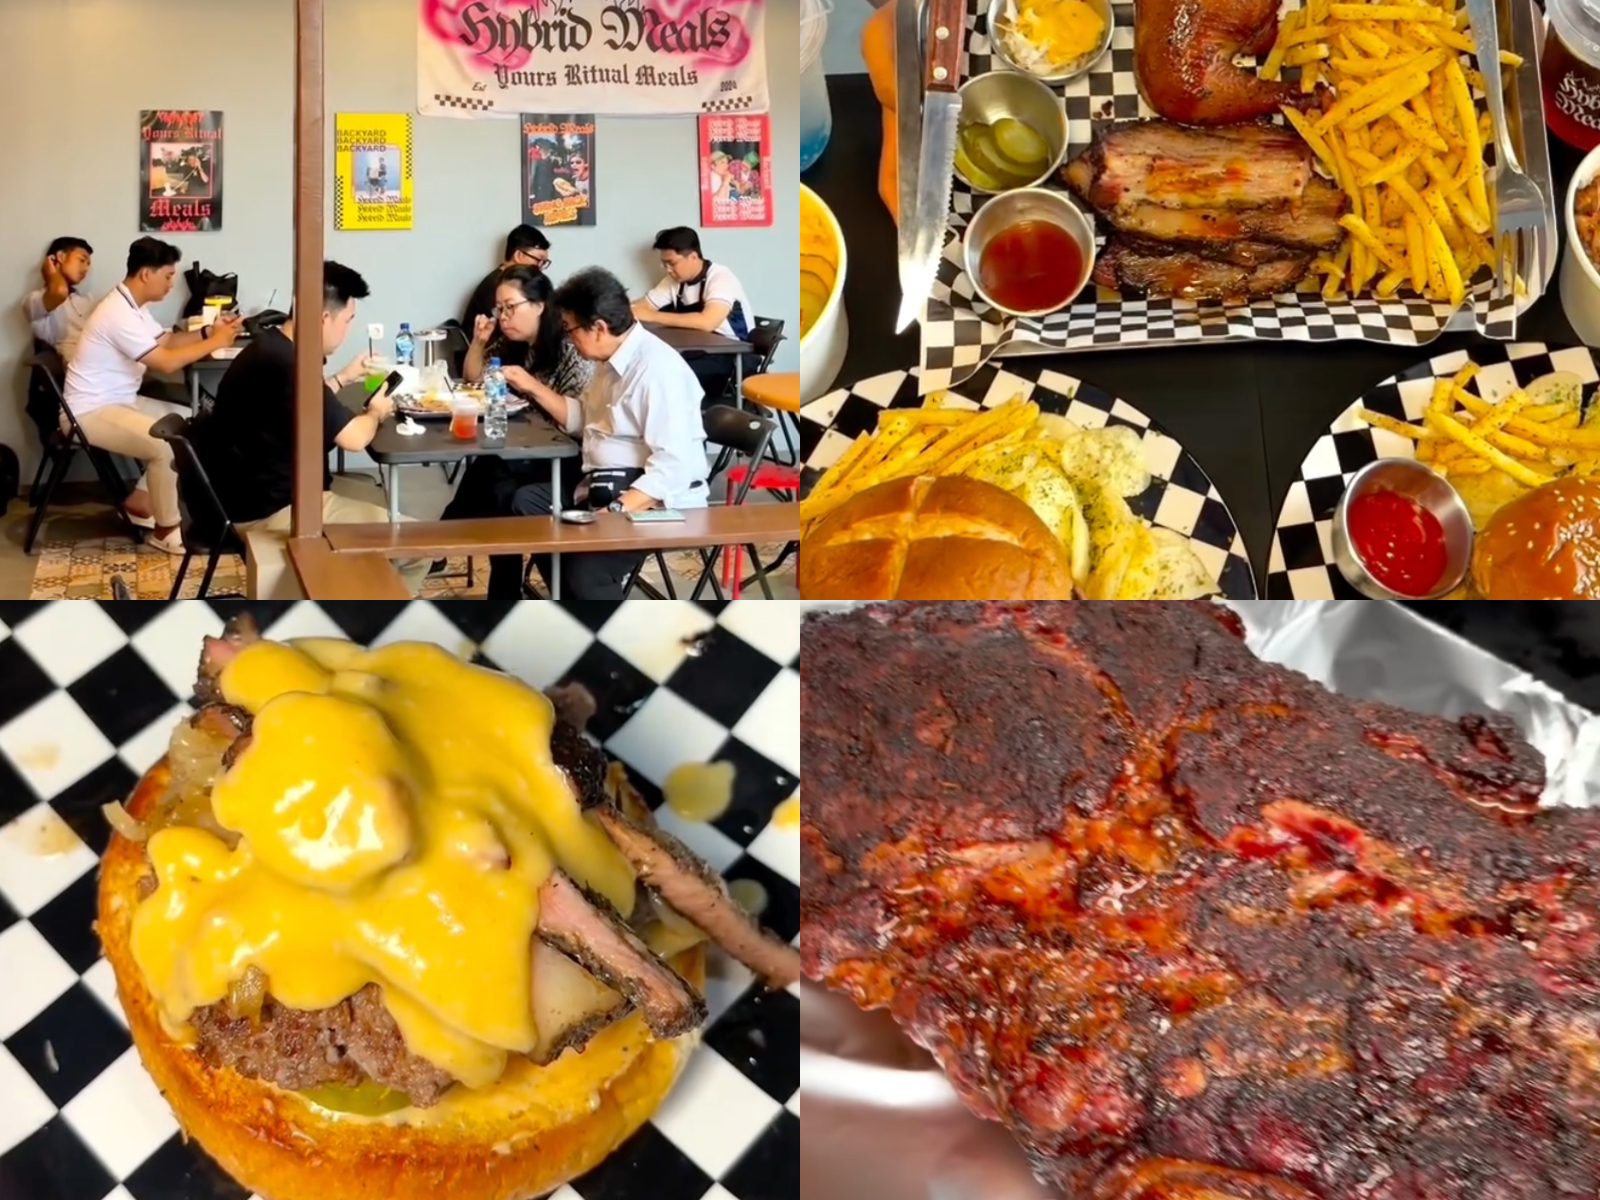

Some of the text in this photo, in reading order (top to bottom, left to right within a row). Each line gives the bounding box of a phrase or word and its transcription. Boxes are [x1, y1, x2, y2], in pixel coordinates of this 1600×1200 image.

[459, 1, 731, 60] Hybrid Meals
[493, 62, 699, 89] Yours Ritual Meals
[141, 126, 180, 141] Yours
[337, 129, 387, 137] BACKYARD
[337, 136, 387, 144] BACKYARD
[149, 198, 212, 217] Meals
